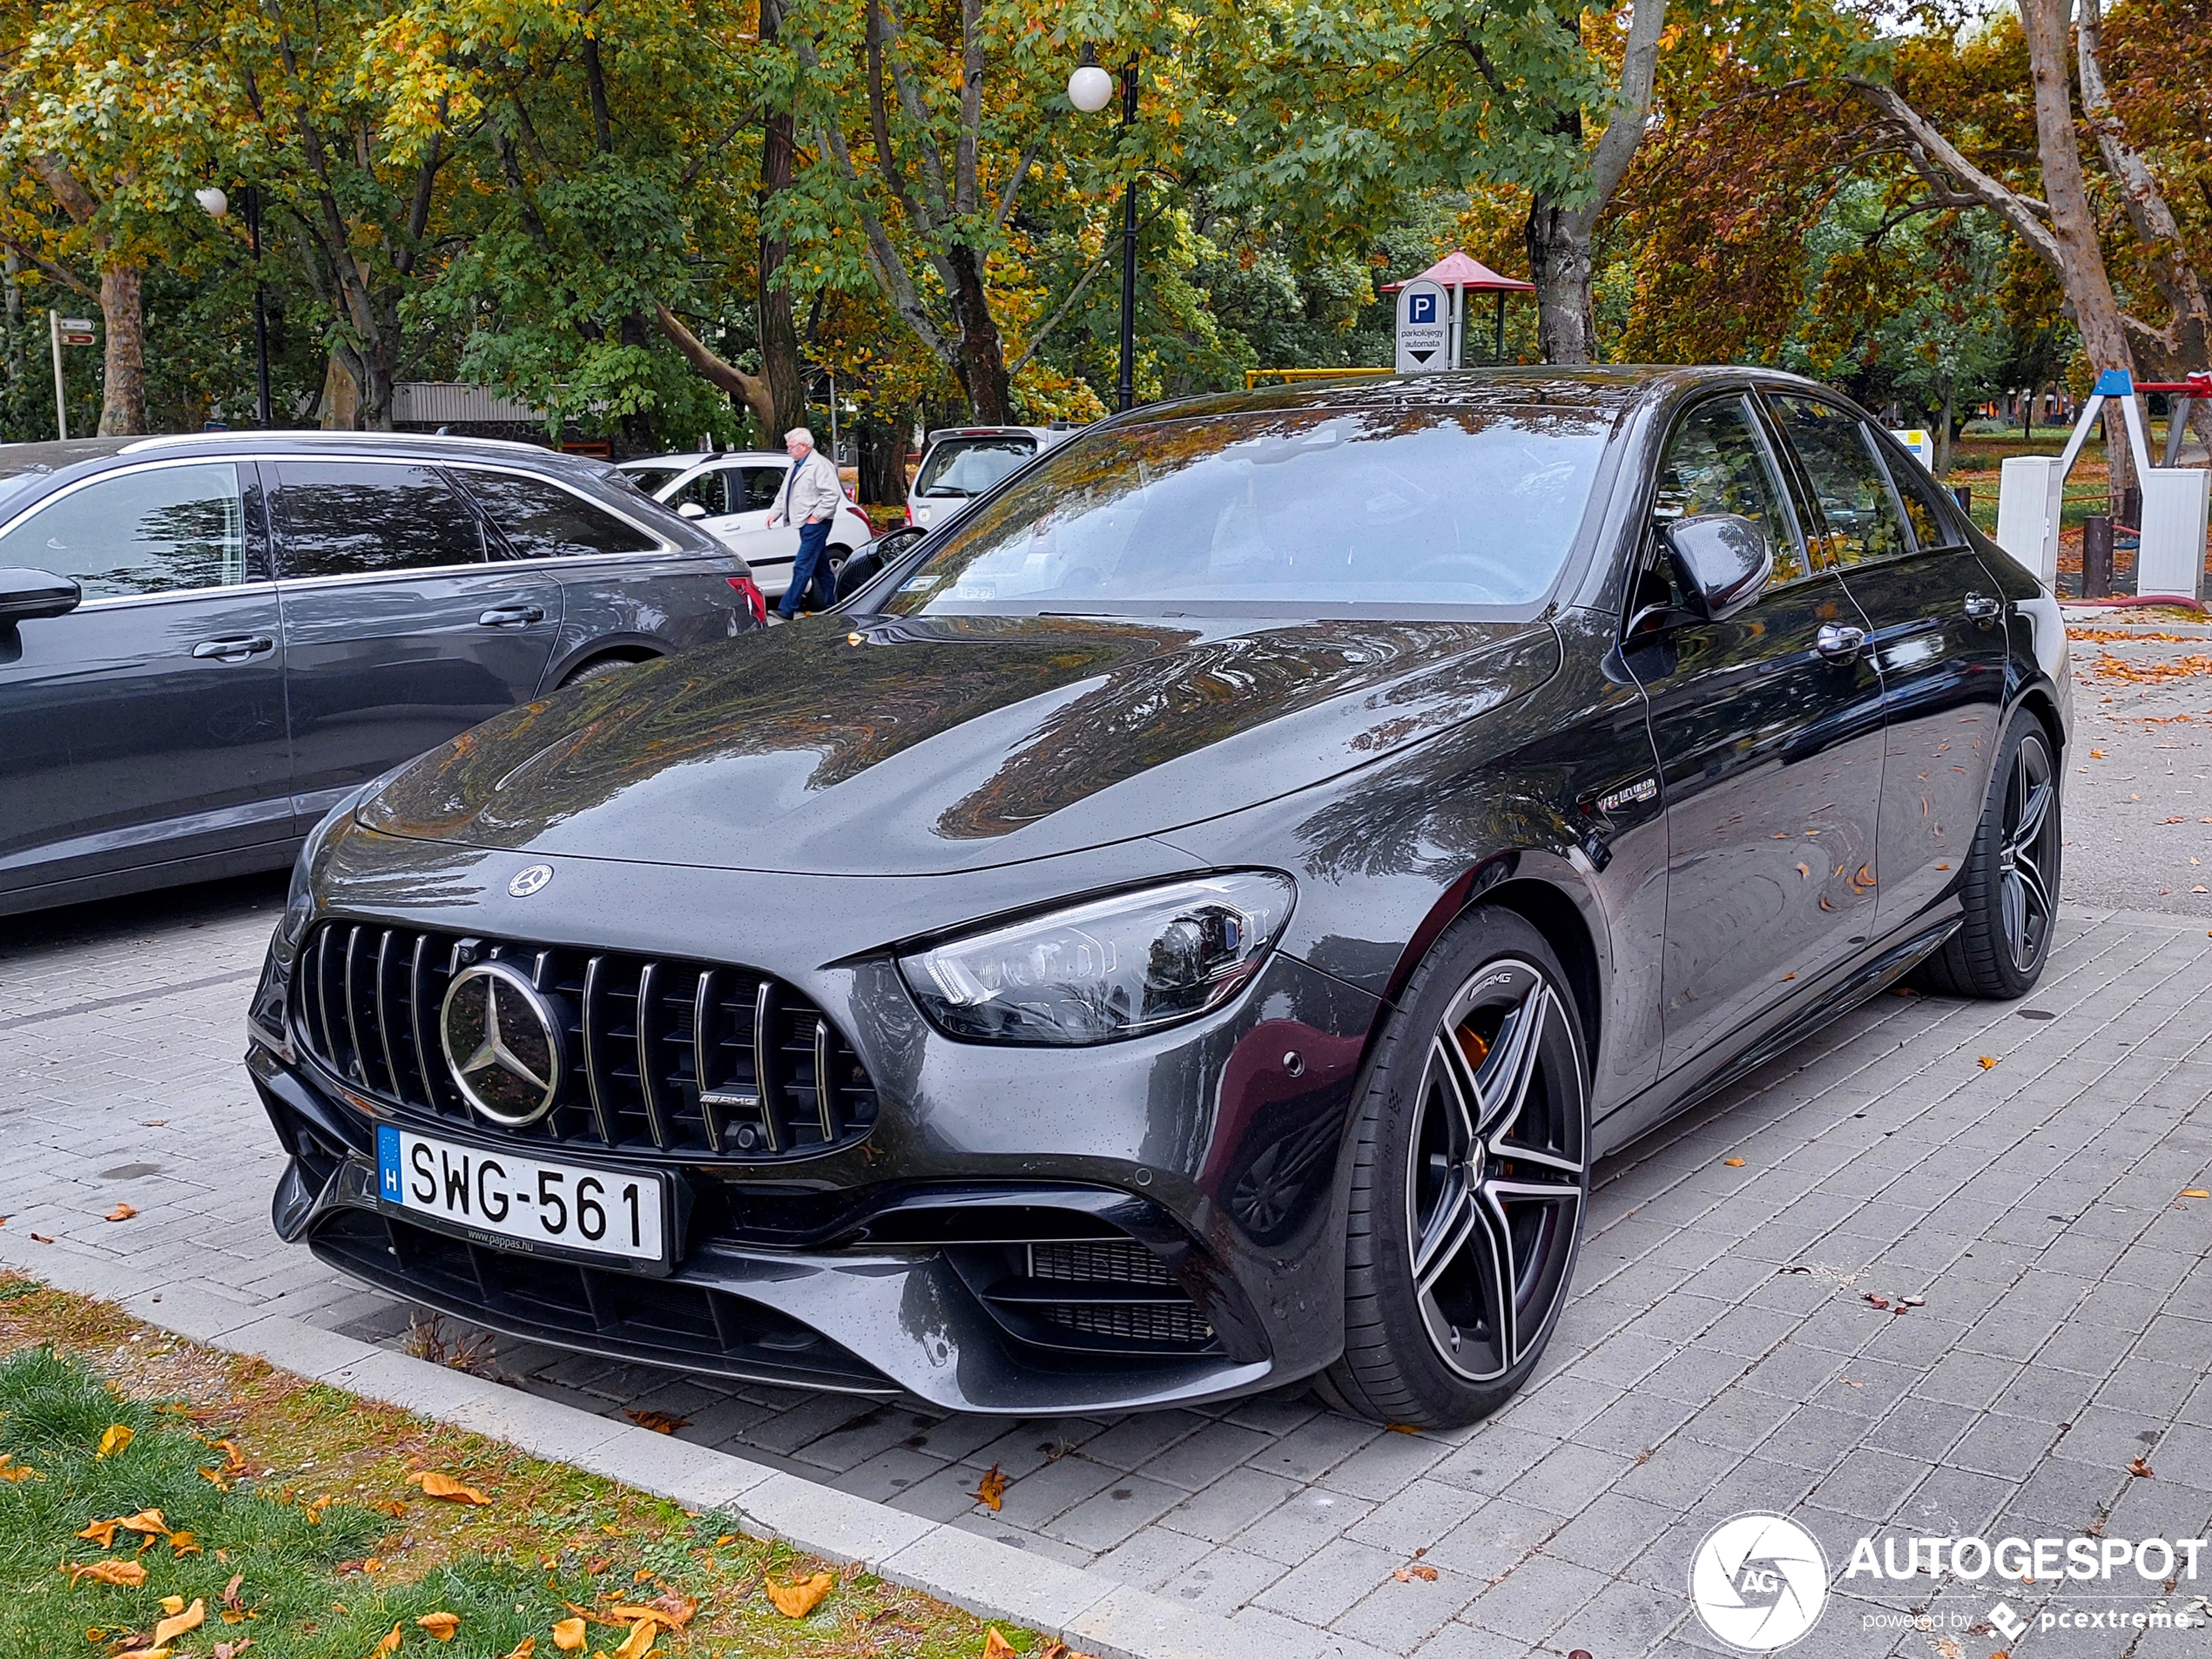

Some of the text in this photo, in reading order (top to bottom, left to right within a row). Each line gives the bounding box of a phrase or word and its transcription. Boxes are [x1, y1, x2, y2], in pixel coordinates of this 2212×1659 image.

[1415, 298, 1431, 320] P
[718, 1096, 758, 1106] AMG
[386, 1168, 397, 1191] H
[411, 1143, 640, 1247] SWG-561
[468, 1230, 534, 1251] www.pappas.hu
